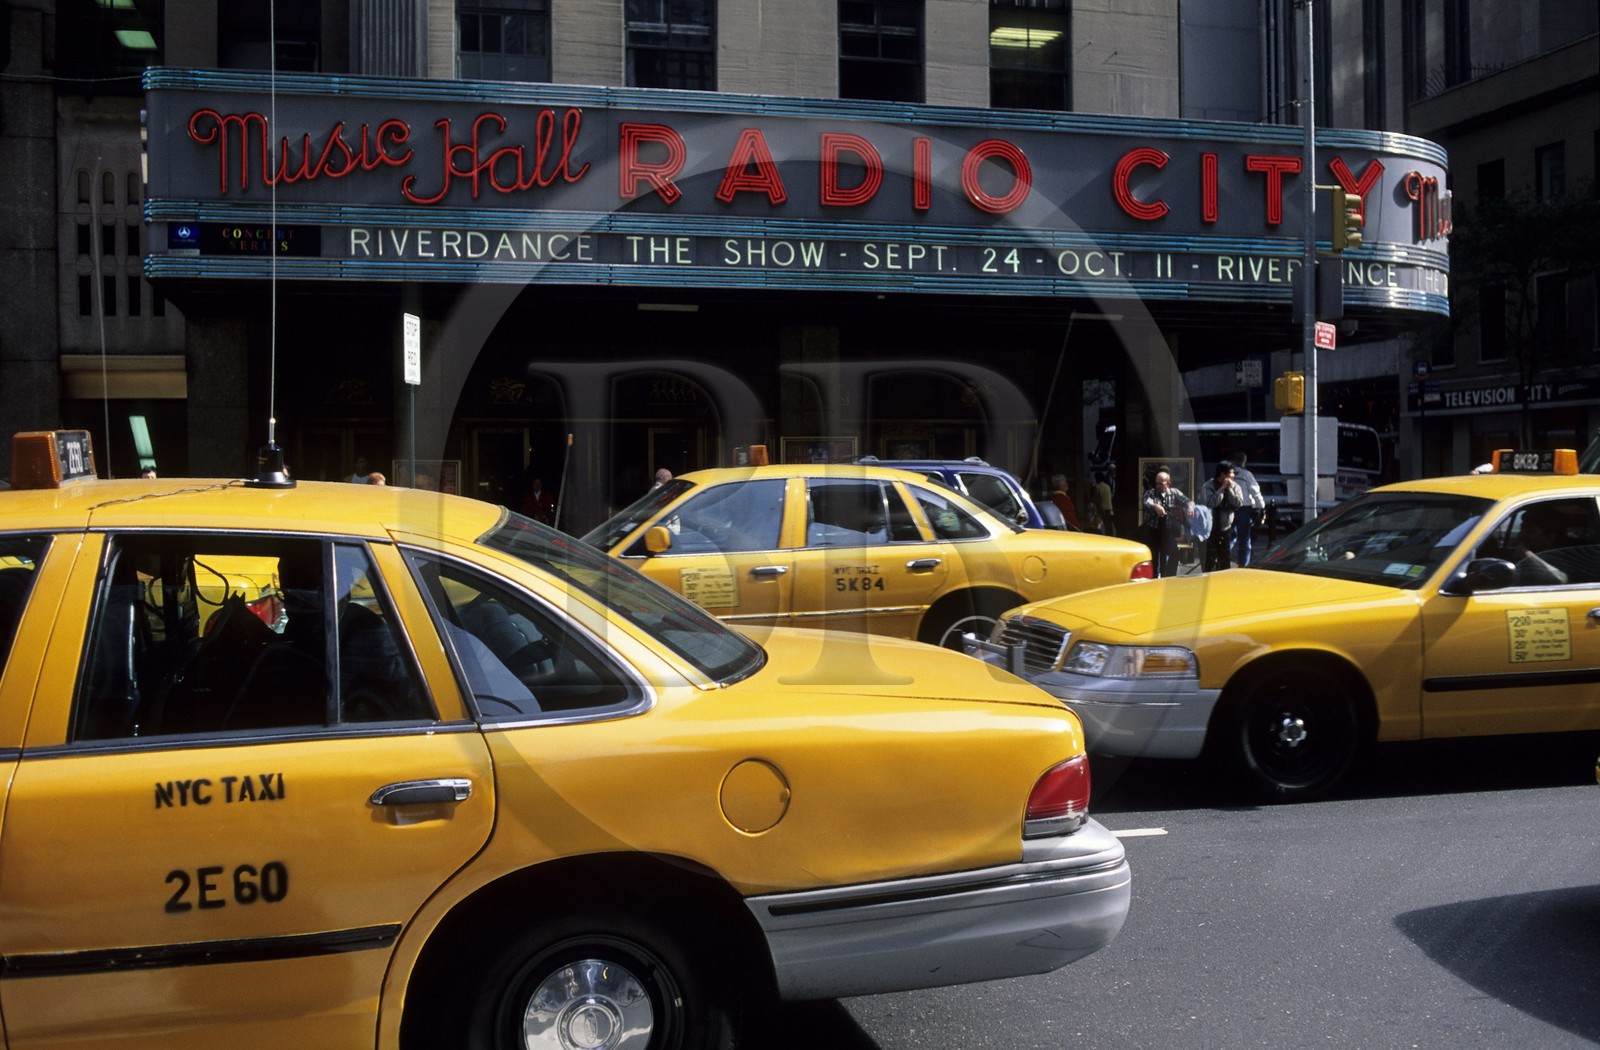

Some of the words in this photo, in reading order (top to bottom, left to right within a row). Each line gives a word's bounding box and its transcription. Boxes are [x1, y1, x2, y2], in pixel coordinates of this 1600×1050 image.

[188, 110, 413, 193] Music
[402, 108, 591, 203] Hall
[620, 122, 1032, 213] RADIO
[1114, 147, 1386, 227] CITY
[351, 228, 594, 262] RIVERDANCE
[626, 237, 692, 264] THE
[724, 239, 825, 268] SHOW
[863, 243, 958, 271] SEPT.
[982, 248, 1020, 273] 24
[1058, 249, 1132, 277] OCT.
[1444, 387, 1516, 407] TELEVISION
[836, 577, 885, 591] 5K84
[154, 778, 213, 809] NYC
[220, 773, 286, 804] TAXI
[163, 861, 289, 914] 2E60
